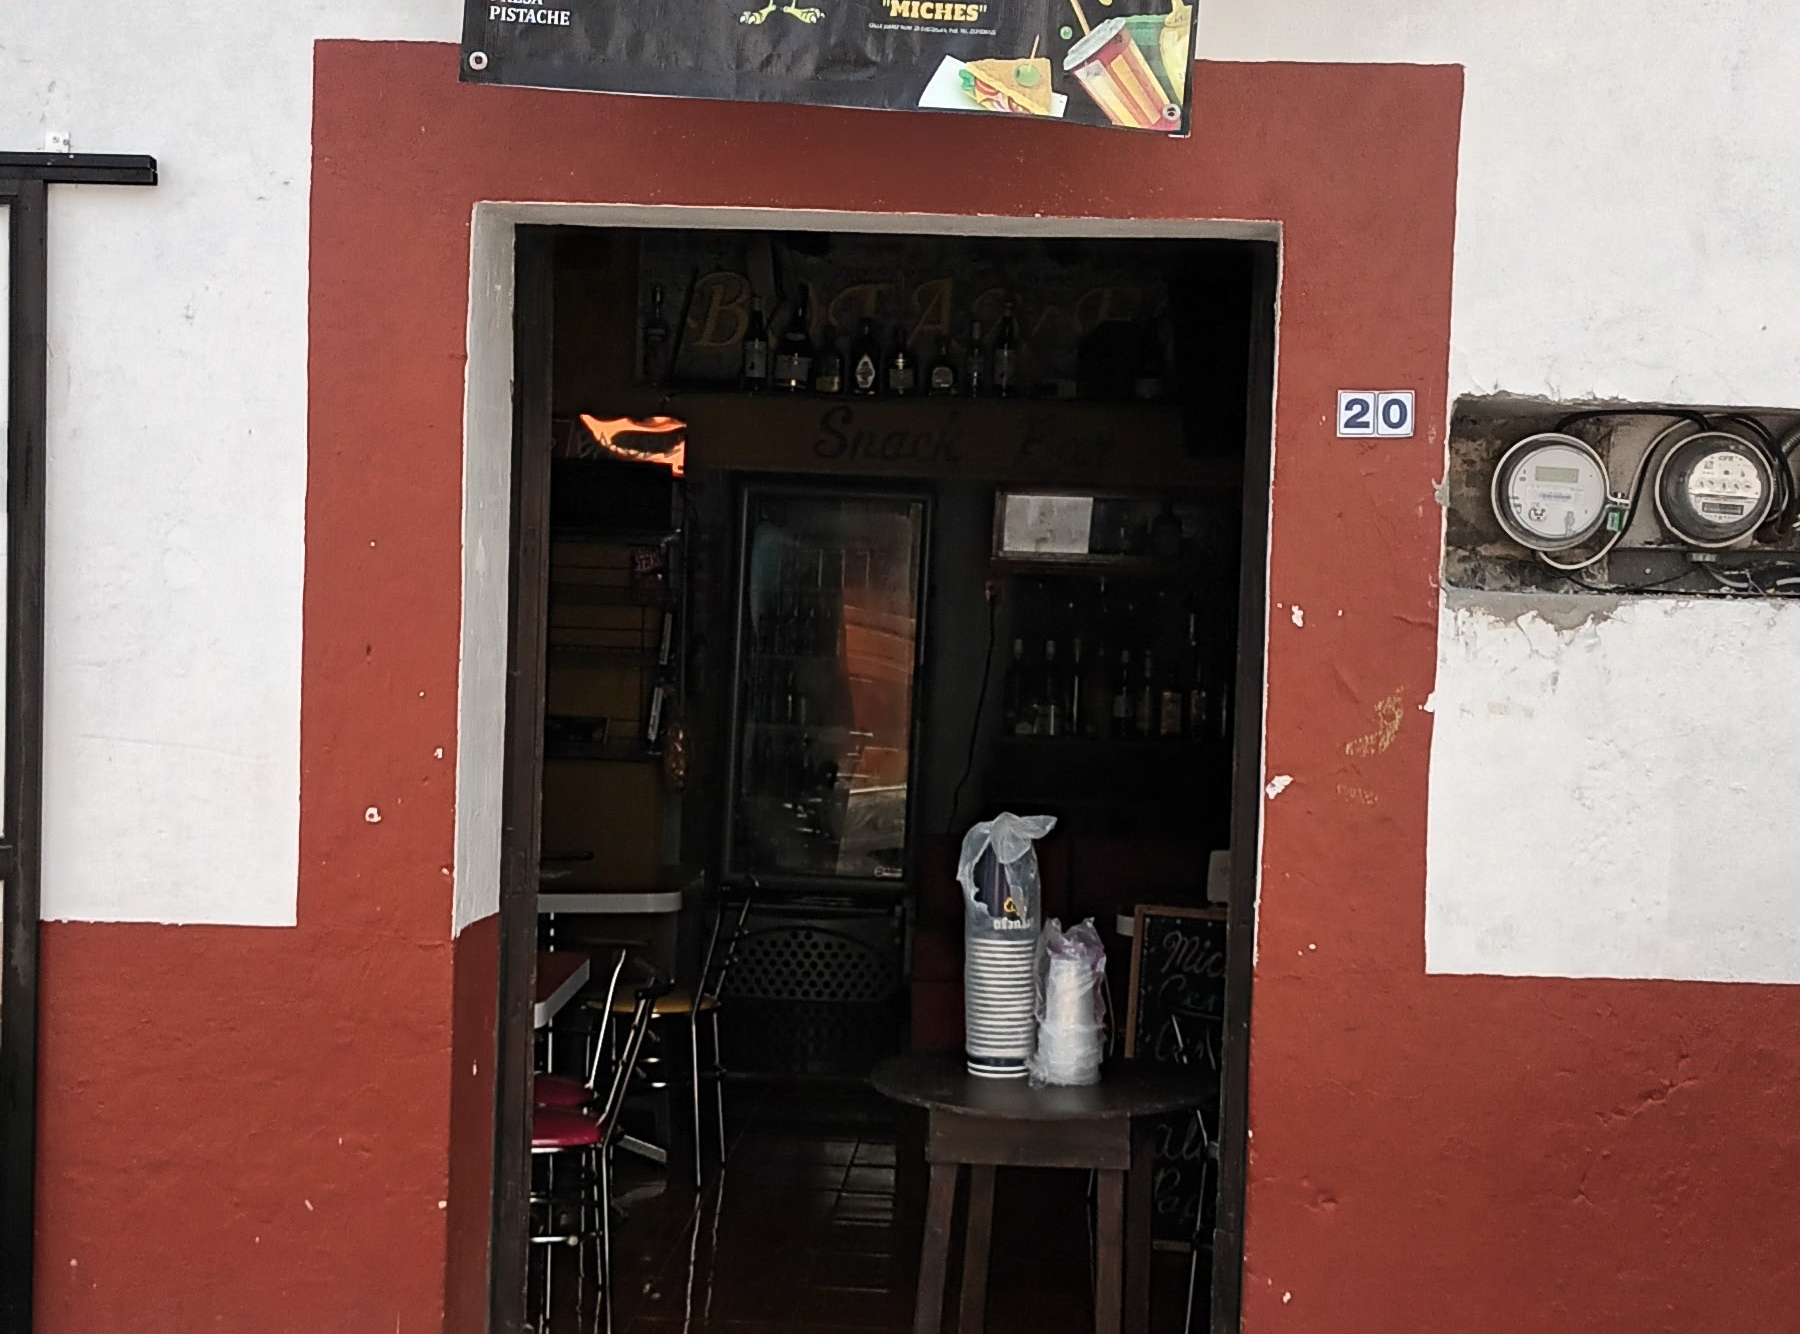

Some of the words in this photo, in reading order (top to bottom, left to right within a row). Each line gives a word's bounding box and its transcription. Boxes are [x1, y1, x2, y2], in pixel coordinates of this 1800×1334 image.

[489, 5, 571, 26] PISTACHE
[1343, 397, 1409, 430] 20
[811, 404, 966, 463] Snack
